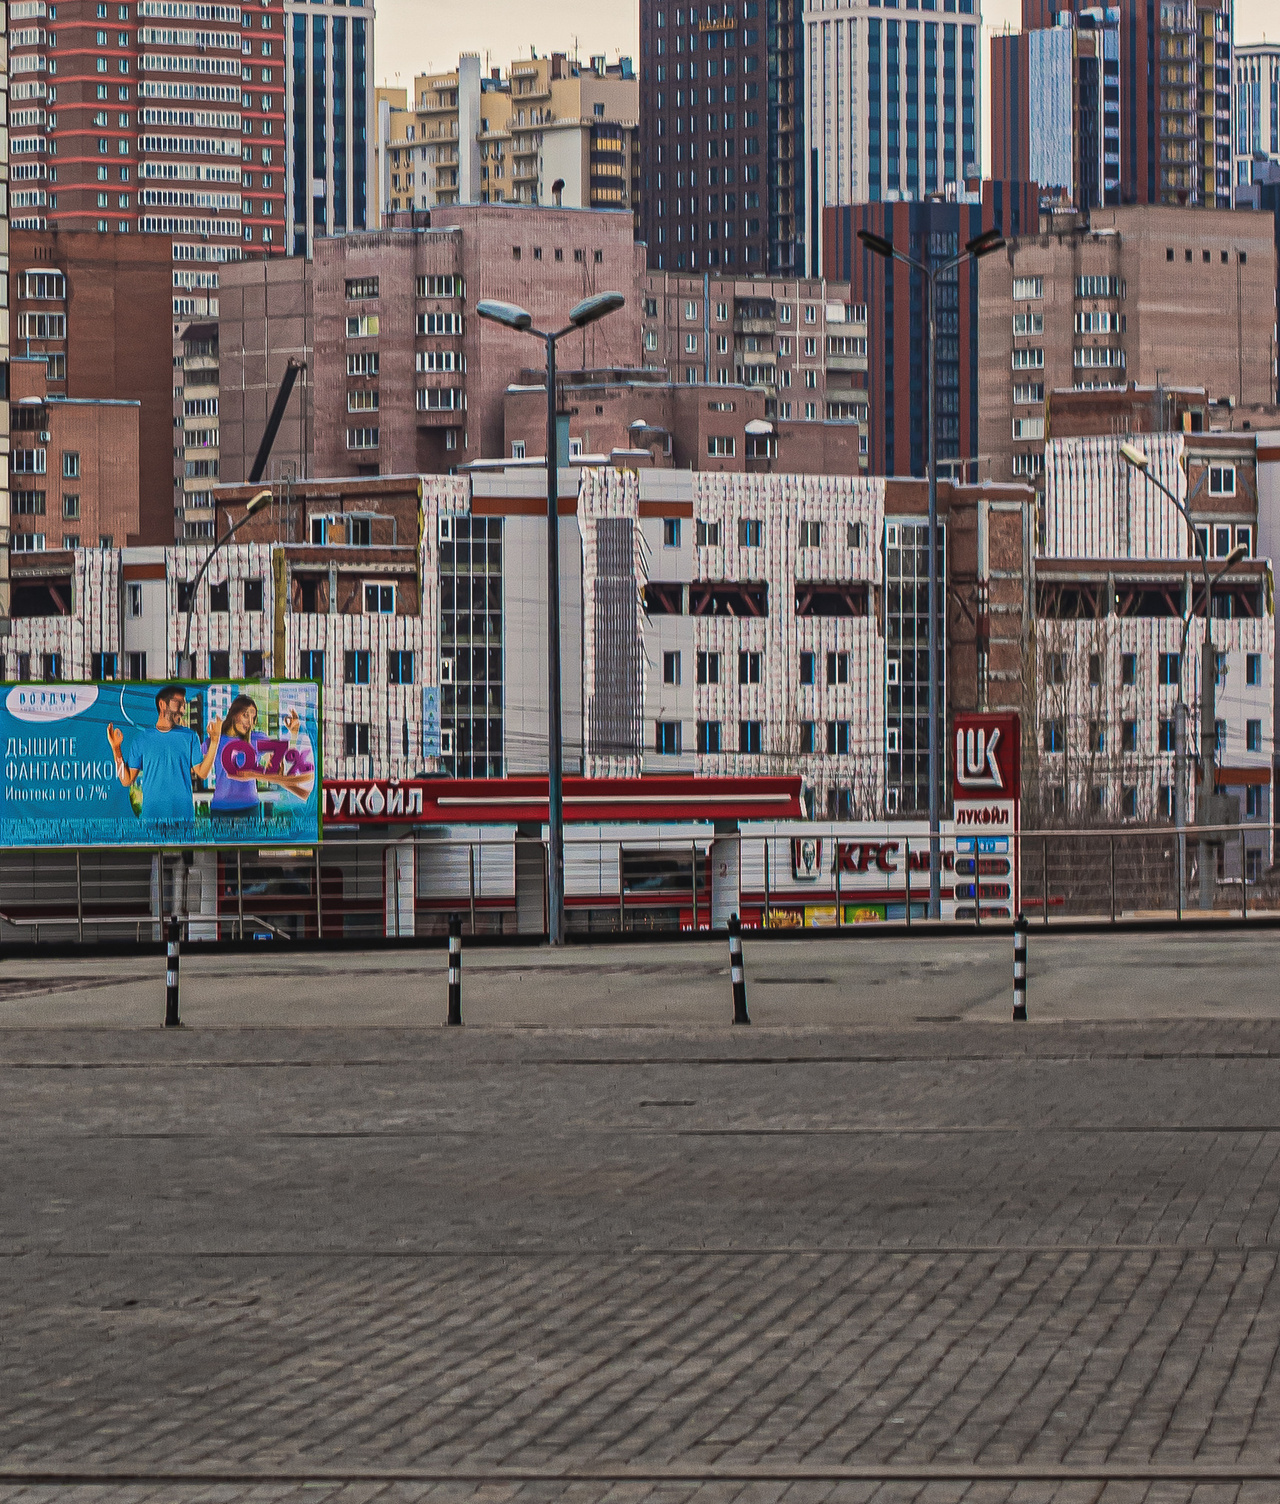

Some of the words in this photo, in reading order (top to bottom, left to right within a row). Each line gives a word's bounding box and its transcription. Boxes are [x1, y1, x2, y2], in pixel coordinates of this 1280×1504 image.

[4, 736, 77, 759] ДЫШИТЕ
[5, 785, 55, 802] Ипотека
[59, 788, 71, 801] от
[956, 806, 1008, 825] ЛУКОЙЛ
[834, 842, 899, 872] KFC
